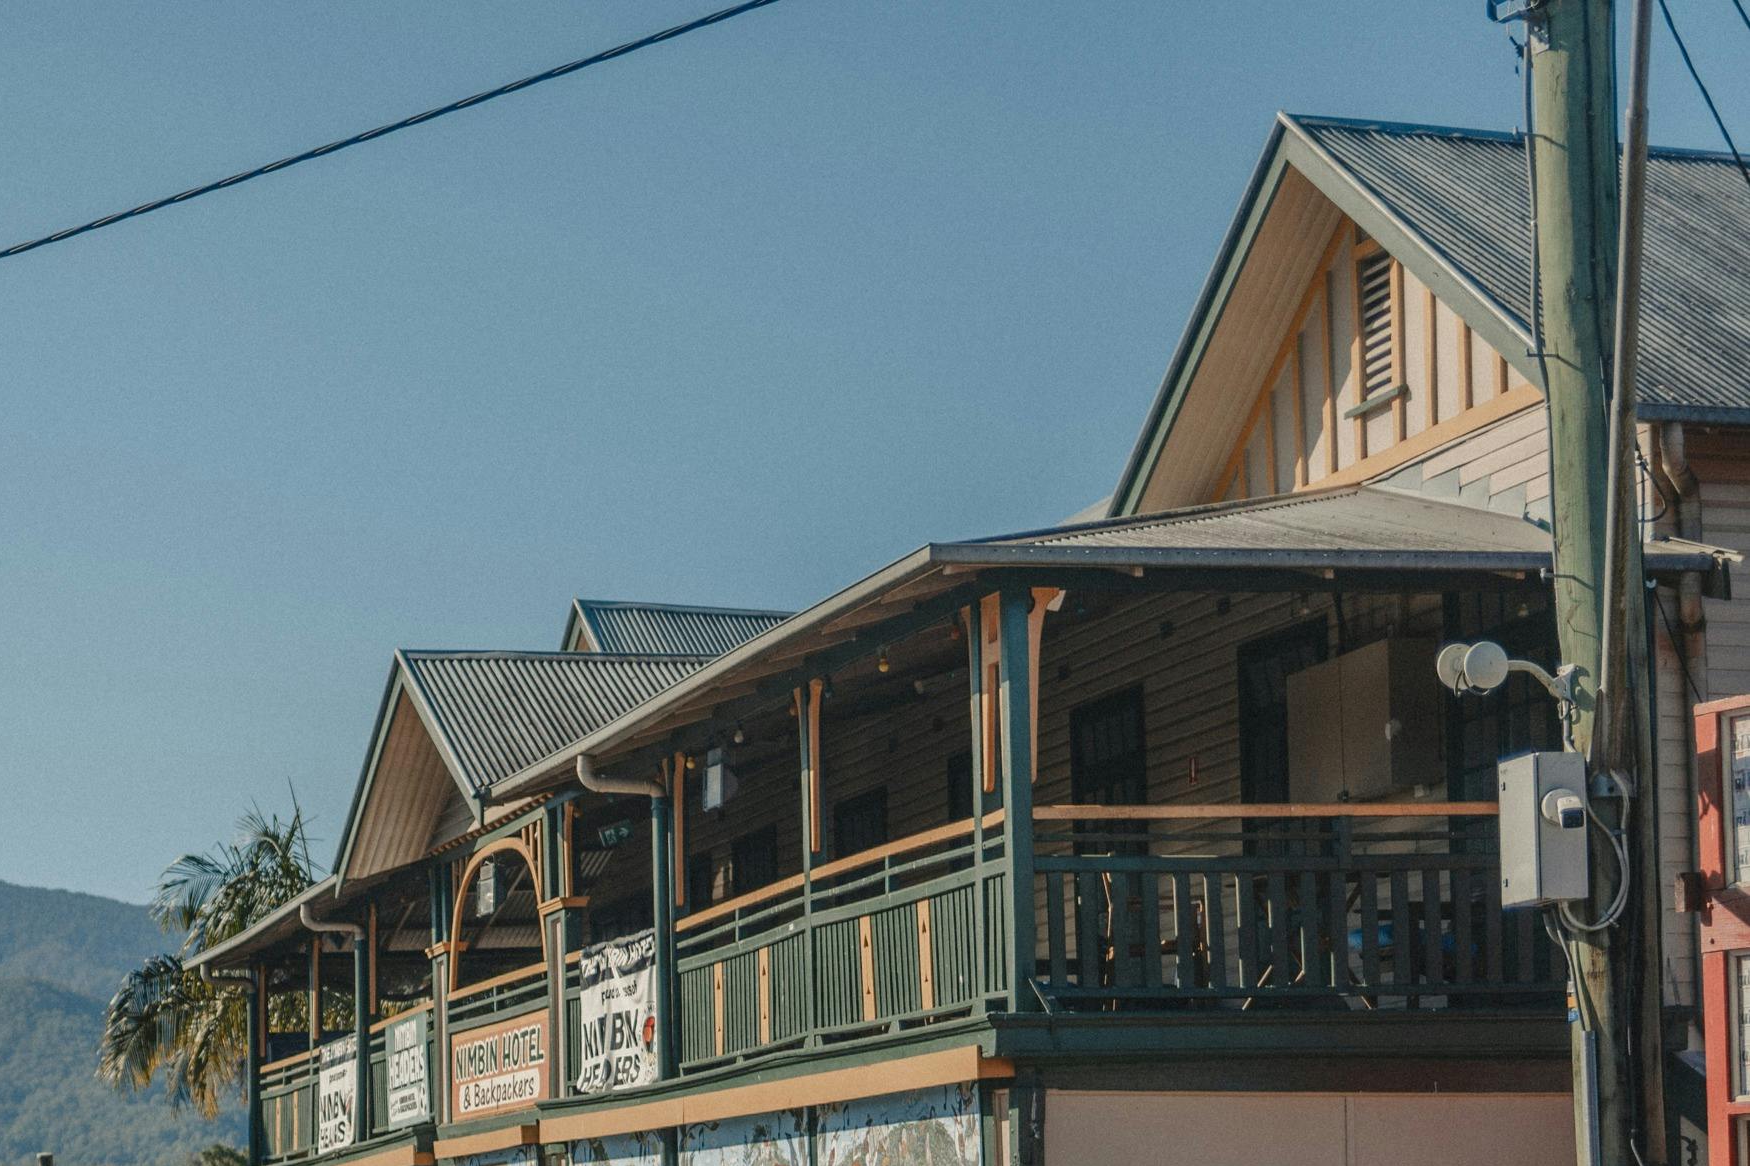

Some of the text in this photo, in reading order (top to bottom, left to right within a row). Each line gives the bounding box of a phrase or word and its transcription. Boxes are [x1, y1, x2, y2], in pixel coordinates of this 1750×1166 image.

[389, 1044, 425, 1090] HEADERS
[456, 1025, 544, 1082] NIMBIN HOTEL
[463, 1074, 534, 1110] & Backpackers
